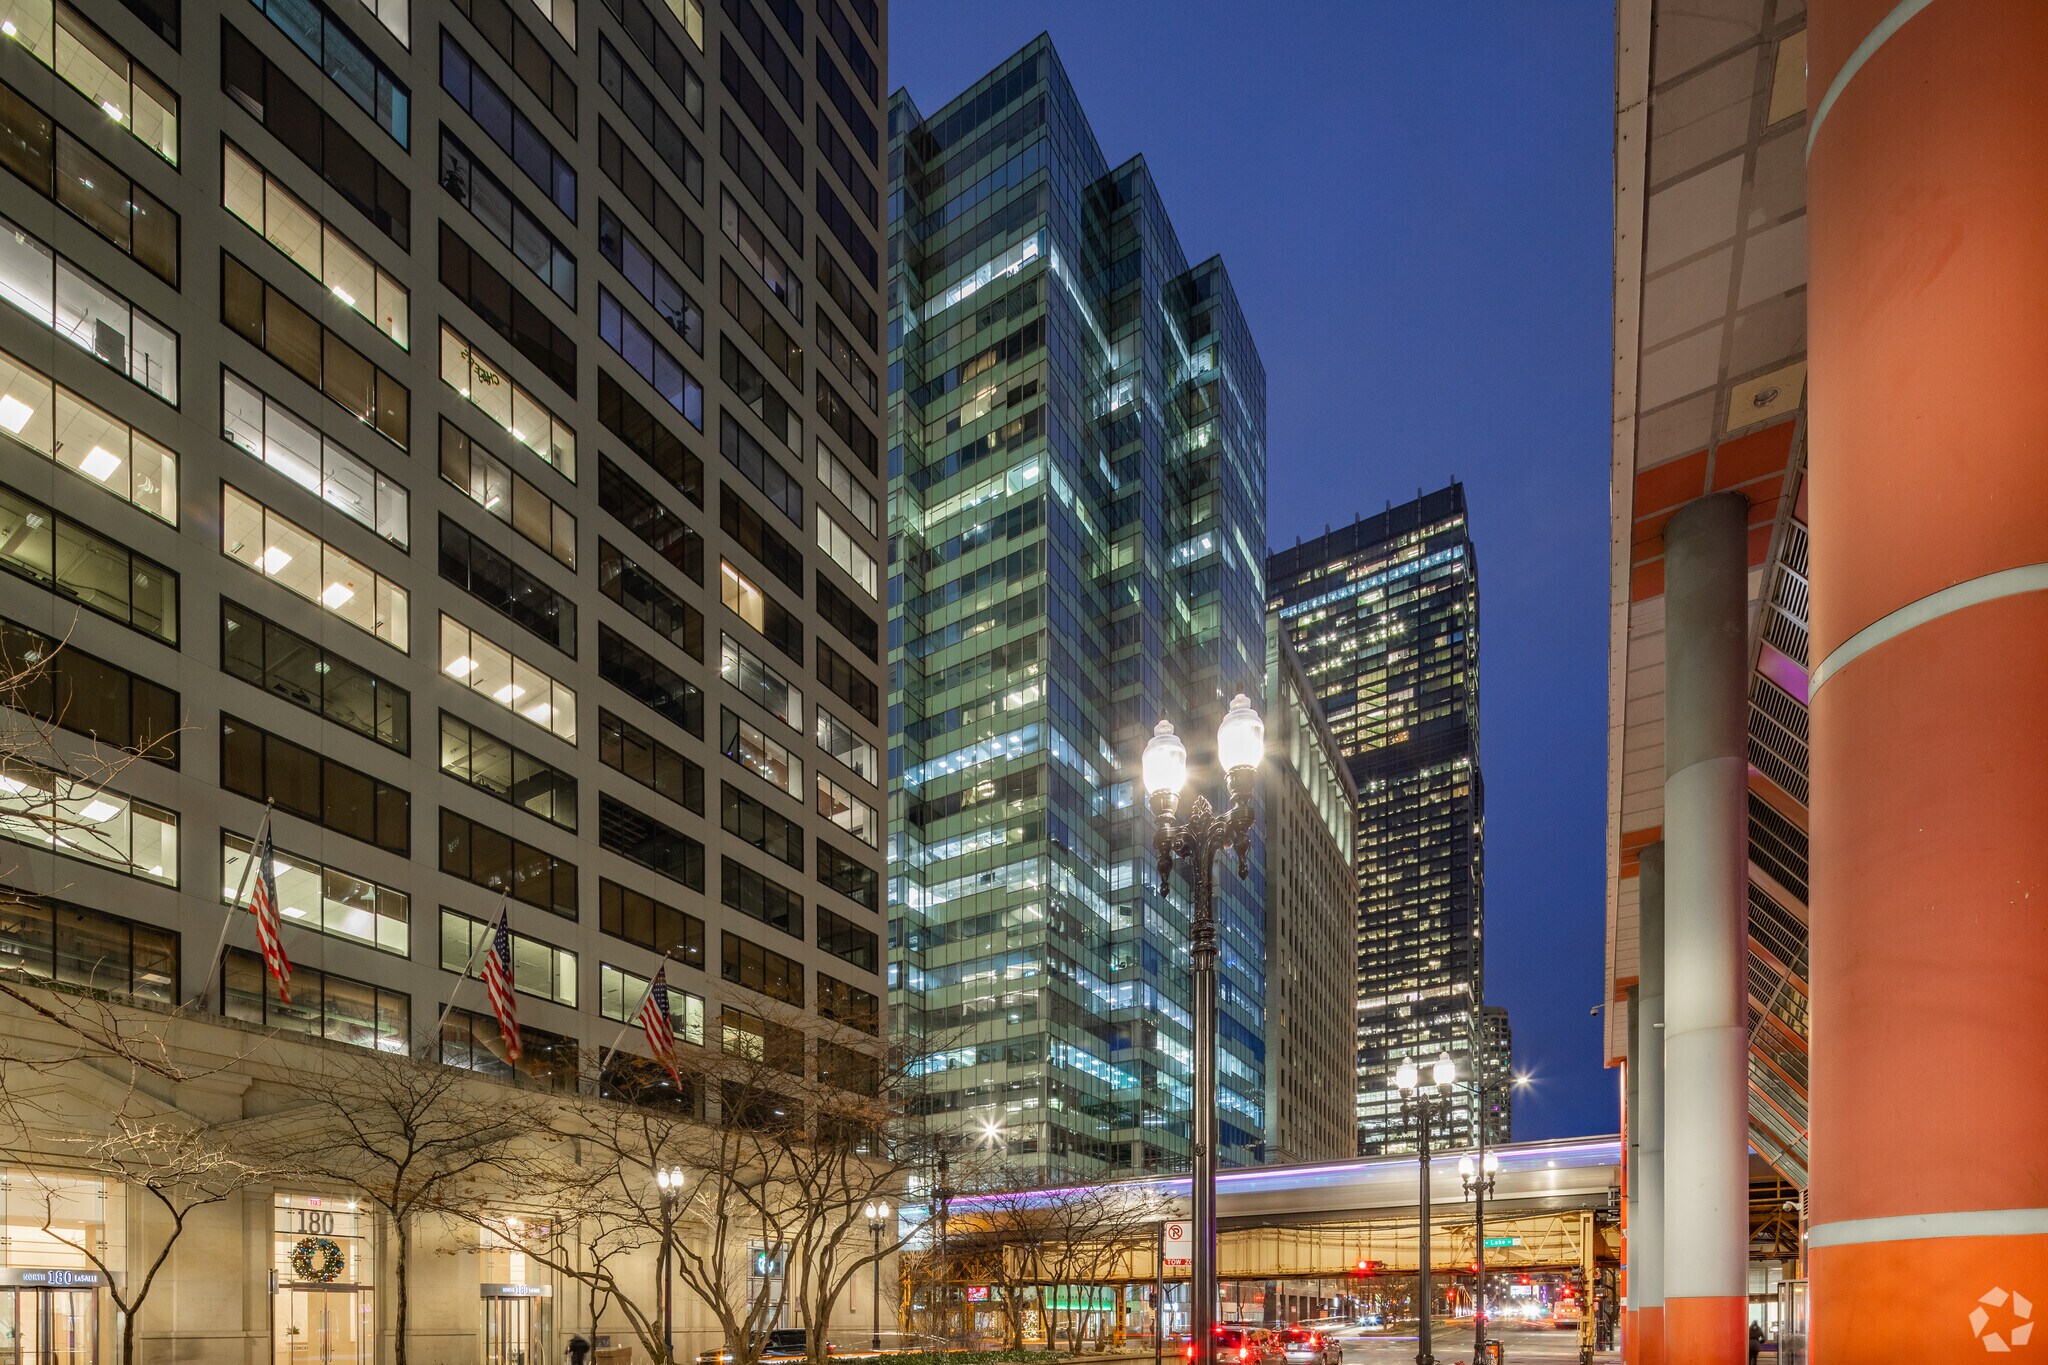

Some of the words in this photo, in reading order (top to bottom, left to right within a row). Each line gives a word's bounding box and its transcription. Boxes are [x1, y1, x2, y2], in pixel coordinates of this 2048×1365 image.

[298, 1210, 334, 1235] 180
[23, 1273, 46, 1281] NORTH
[48, 1270, 73, 1285] 180
